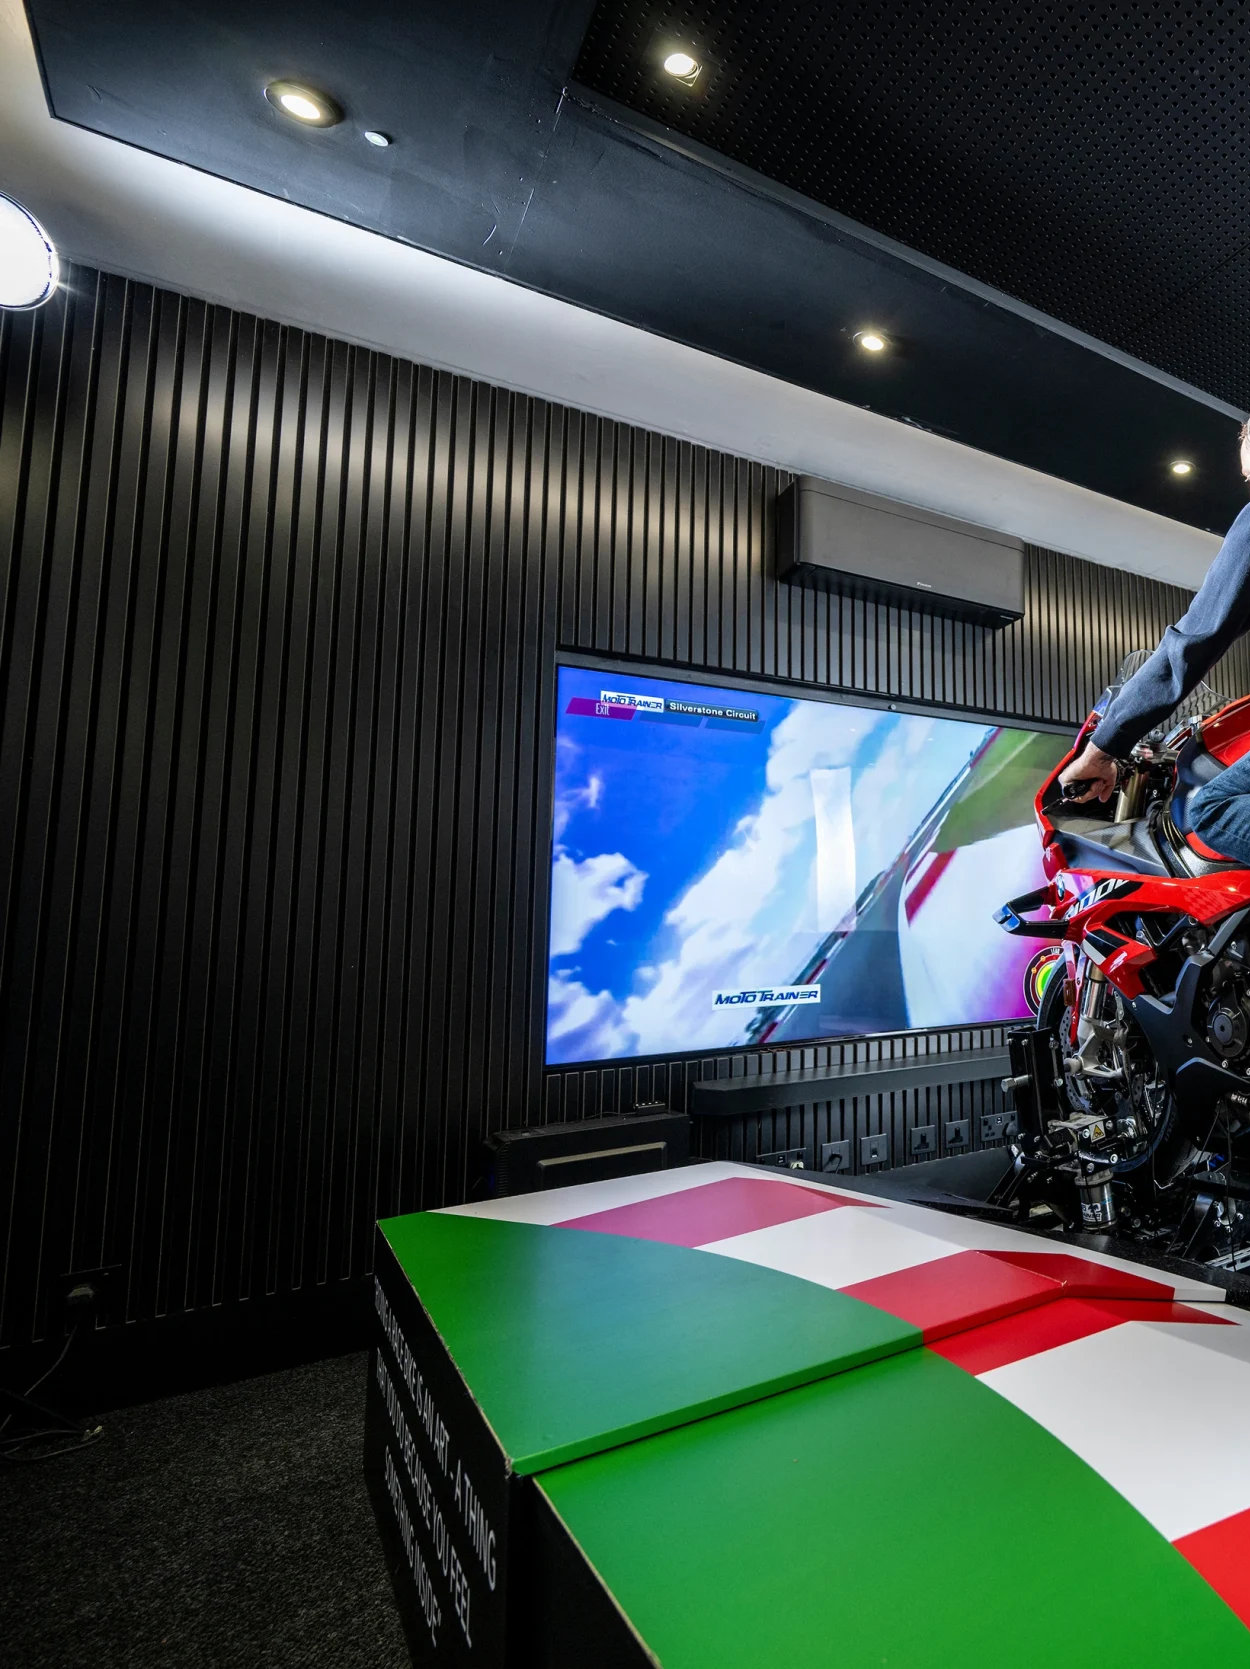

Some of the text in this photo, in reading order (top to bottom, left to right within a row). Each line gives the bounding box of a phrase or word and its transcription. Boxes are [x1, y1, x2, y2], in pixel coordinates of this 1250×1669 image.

[595, 702, 610, 716] Exit
[669, 702, 756, 720] Silverstone Circuit
[385, 1445, 415, 1568] SOMETHING
[387, 1373, 398, 1427] YOU
[395, 1400, 405, 1449] DO
[404, 1423, 432, 1530] BECAUSE
[432, 1496, 450, 1577] YOU
[450, 1545, 472, 1648] FEEL
[391, 1314, 405, 1371] RACE
[404, 1342, 417, 1401] BIKE
[416, 1371, 424, 1416] IS
[422, 1388, 435, 1443] AN
[434, 1412, 450, 1477] ART
[454, 1459, 462, 1512] A
[464, 1472, 496, 1591] THING
